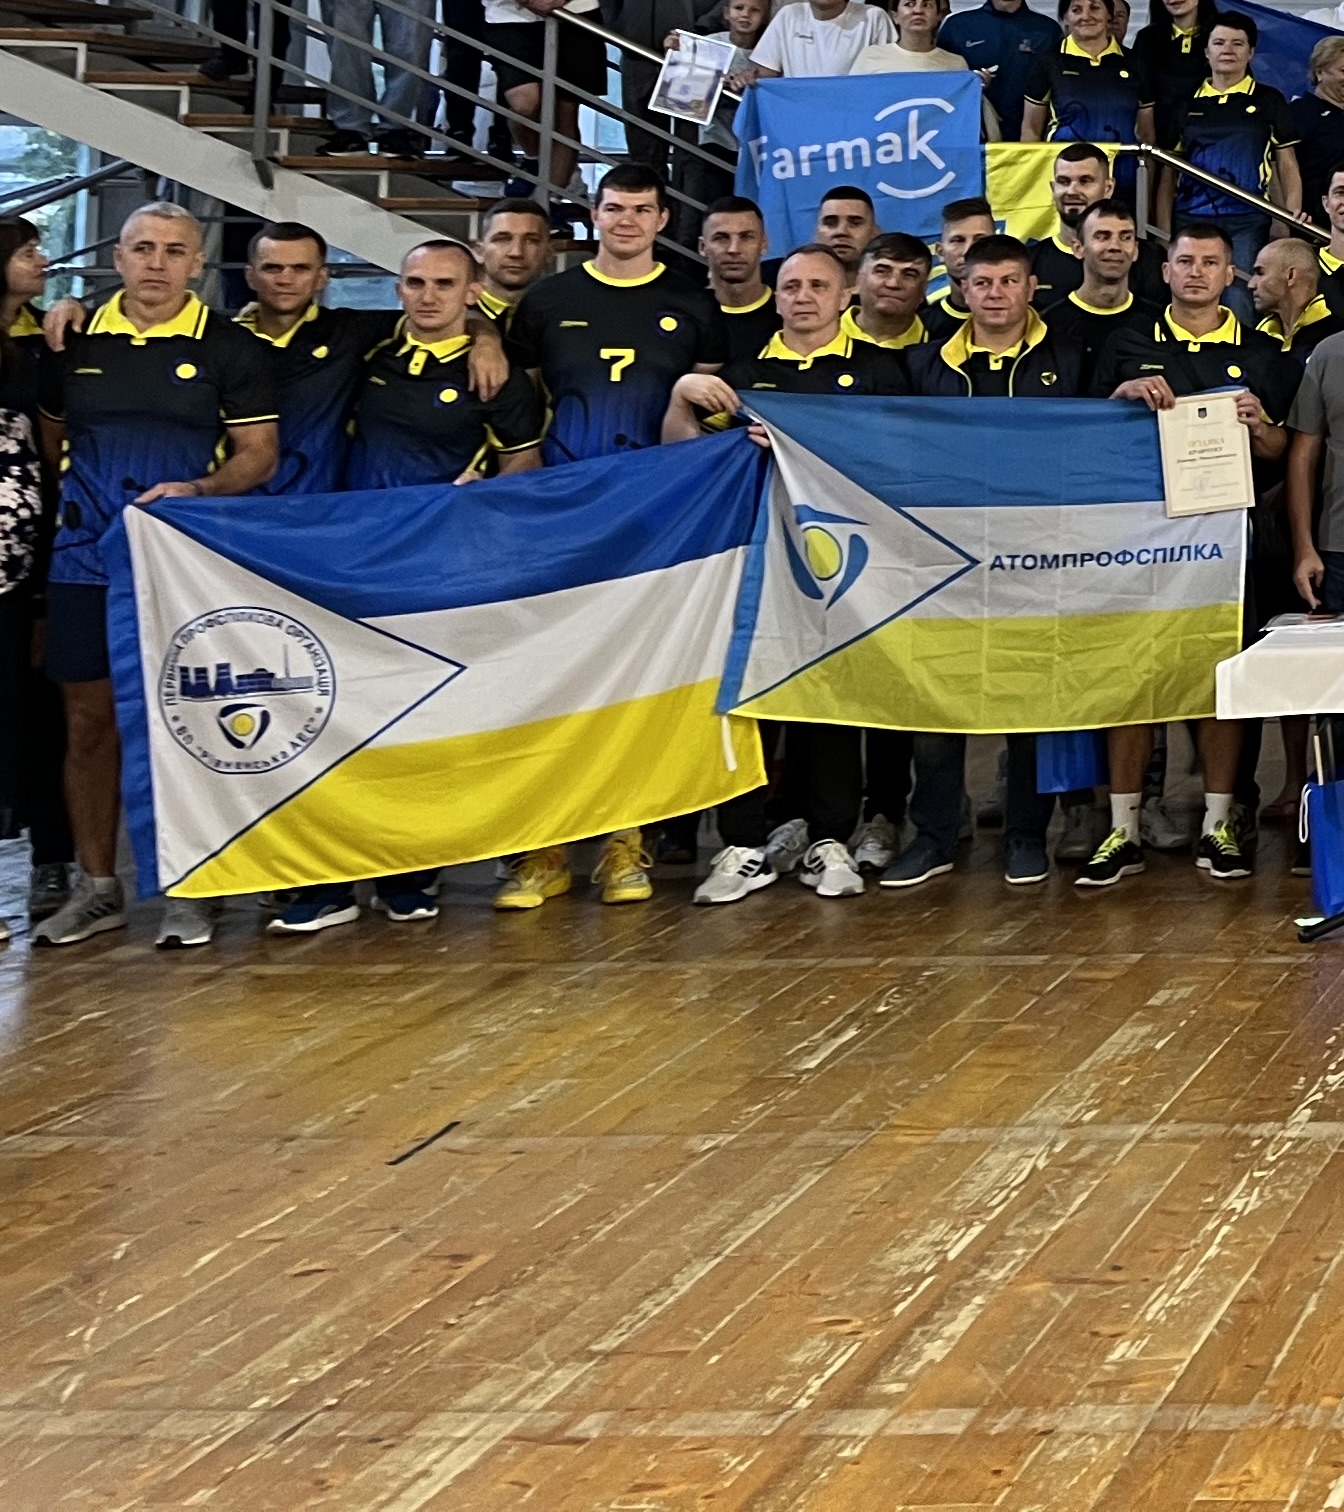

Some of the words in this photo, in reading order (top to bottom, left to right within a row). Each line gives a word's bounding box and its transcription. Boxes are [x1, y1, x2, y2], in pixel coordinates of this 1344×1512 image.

[749, 109, 946, 186] Farmak
[600, 348, 636, 382] 7
[989, 543, 1224, 572] АТОМПРОФСПІЛКА
